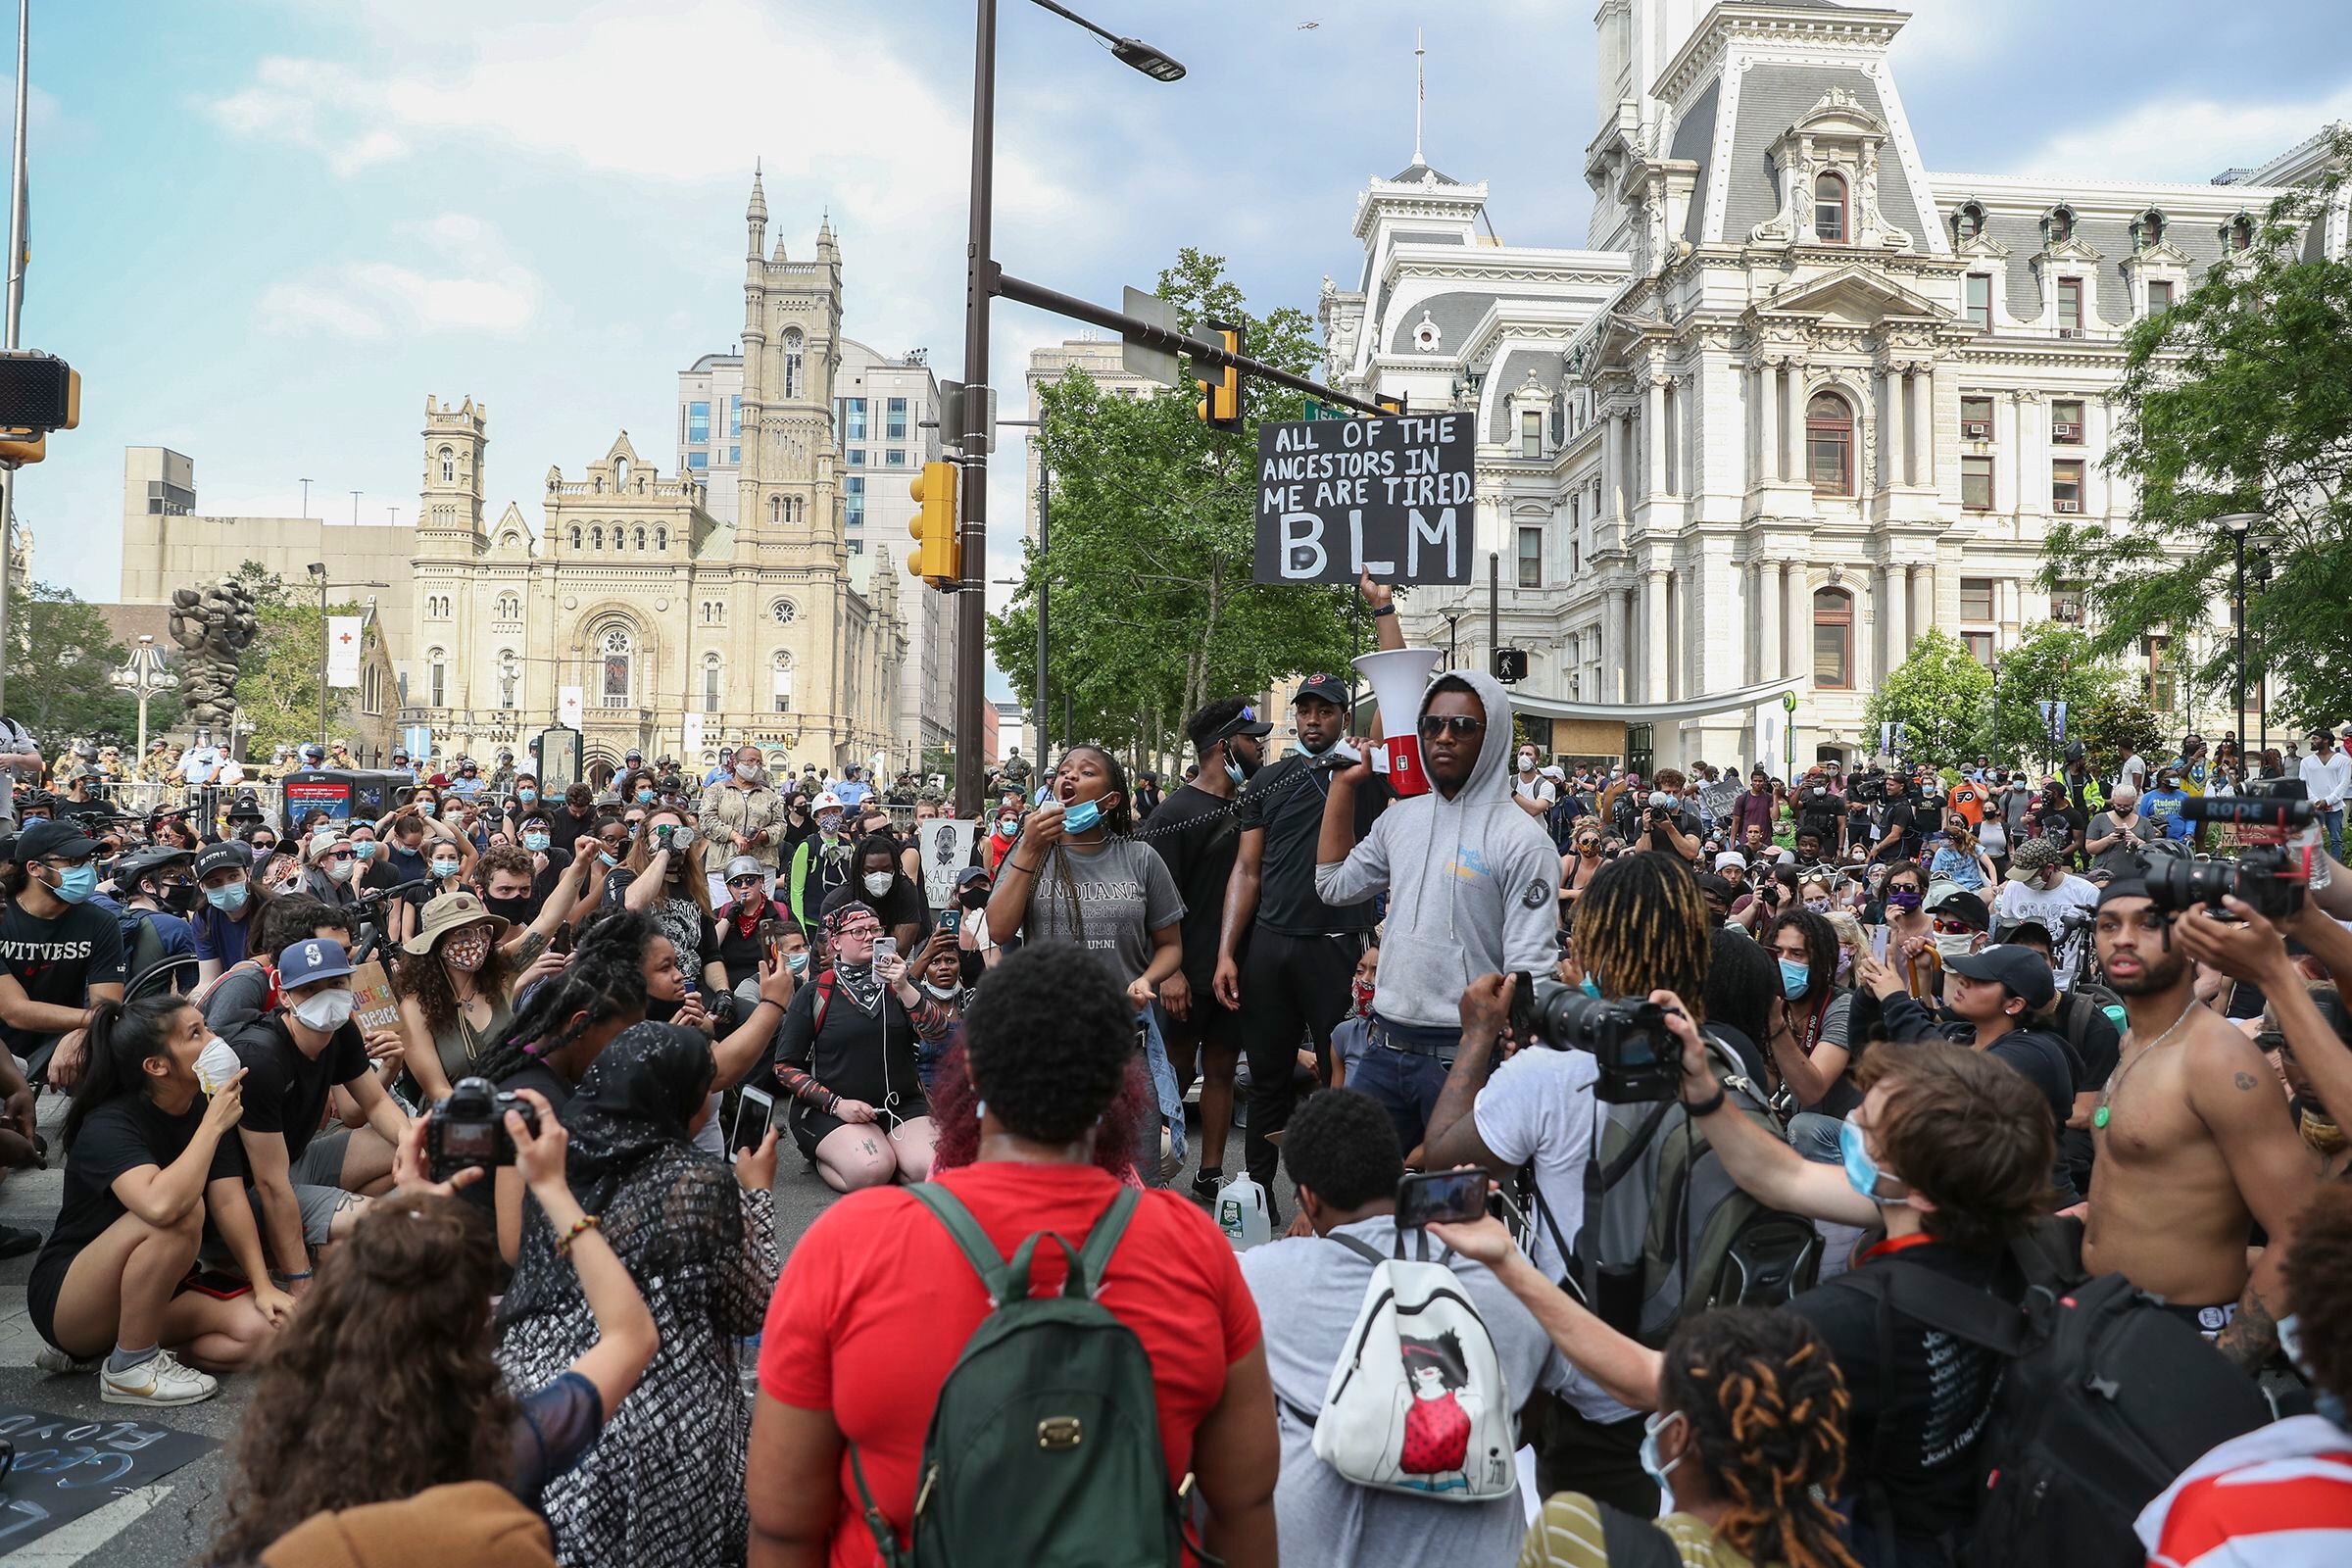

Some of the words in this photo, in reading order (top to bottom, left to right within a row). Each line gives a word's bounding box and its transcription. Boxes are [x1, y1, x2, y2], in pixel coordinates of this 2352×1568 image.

[1275, 426, 1319, 453] ALL
[1343, 419, 1383, 448] OF
[1397, 416, 1456, 444] THE
[1262, 450, 1395, 481] ANCESTORS
[1404, 445, 1439, 475] IN
[1263, 485, 1304, 514] ME
[1314, 478, 1369, 508] ARE
[1383, 471, 1474, 507] TIRED.
[1038, 878, 1144, 902] INDIANA
[2017, 903, 2072, 918] GRACE
[359, 1004, 400, 1035] peace
